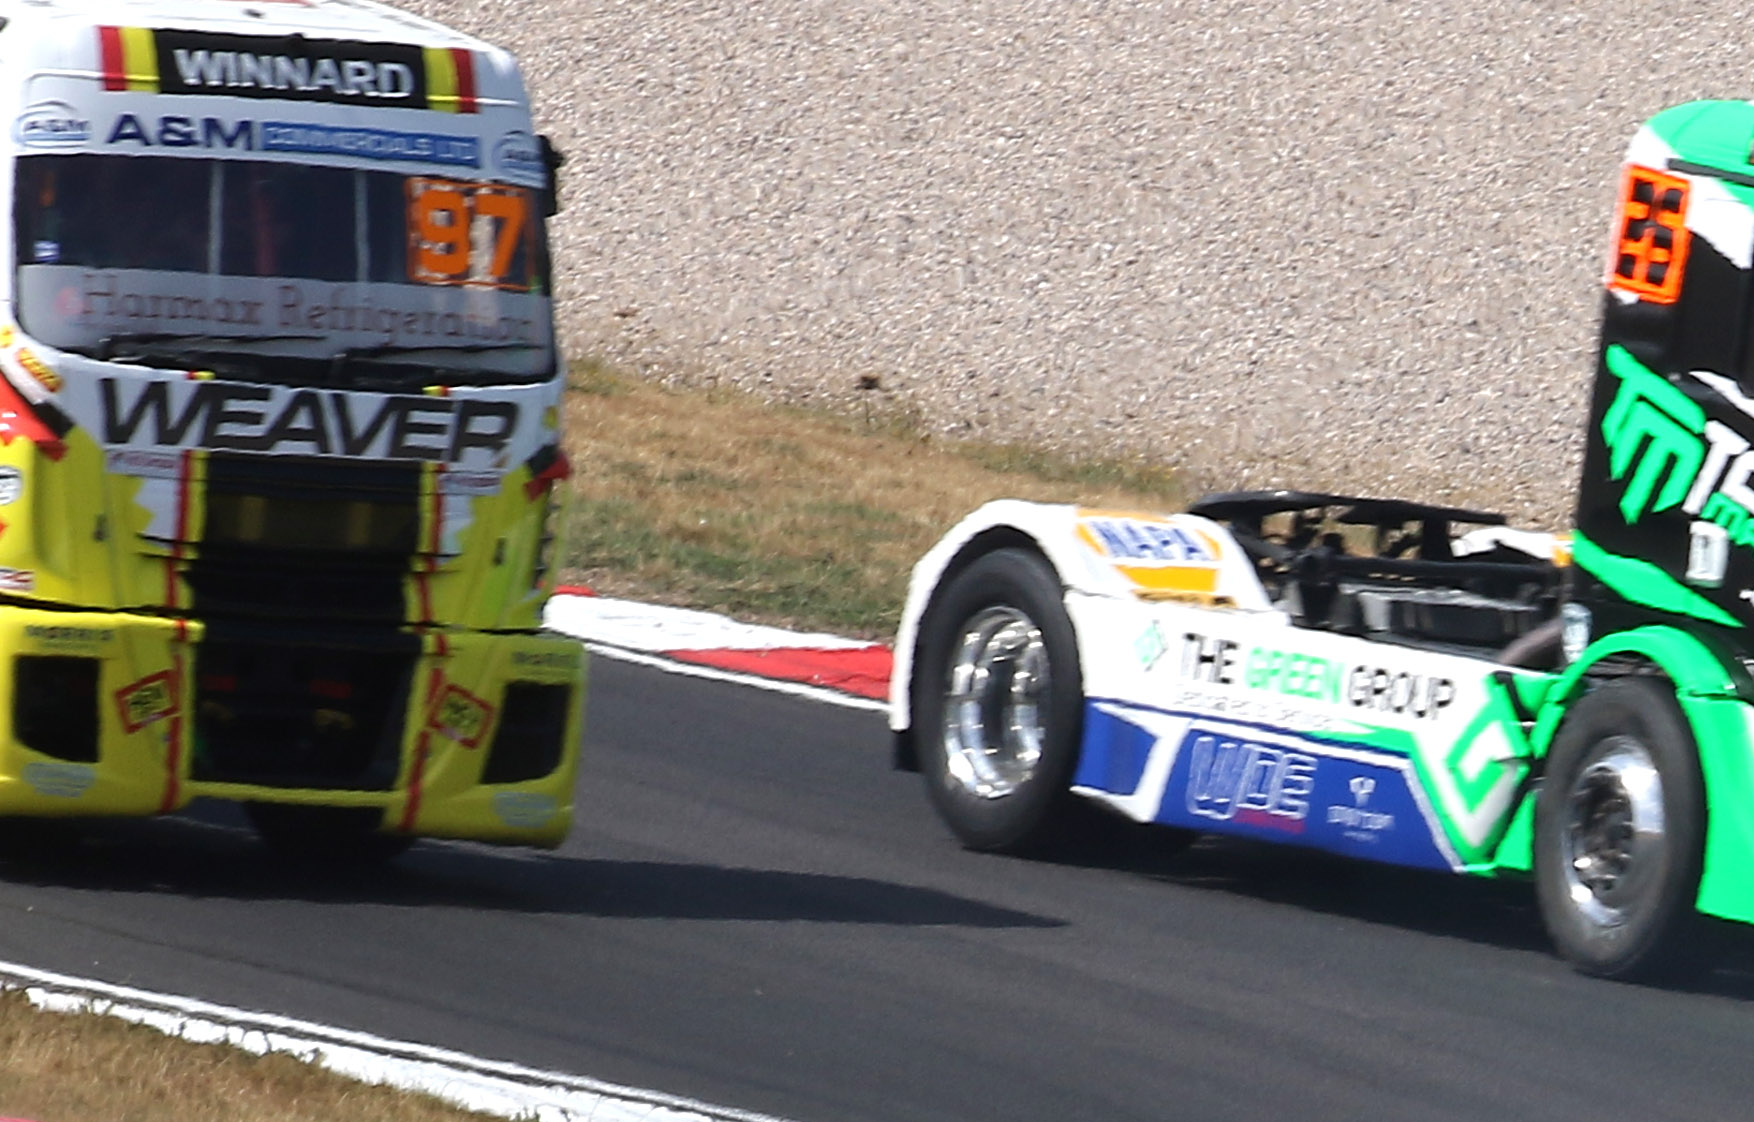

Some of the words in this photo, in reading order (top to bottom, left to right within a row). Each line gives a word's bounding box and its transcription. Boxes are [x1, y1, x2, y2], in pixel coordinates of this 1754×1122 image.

[176, 49, 413, 98] WINNARD
[106, 113, 253, 151] A&M
[417, 187, 527, 277] 97
[101, 378, 519, 462] WEAVER
[1182, 632, 1242, 685] THE
[1246, 646, 1345, 704] GREEN
[1348, 665, 1457, 720] GROUP
